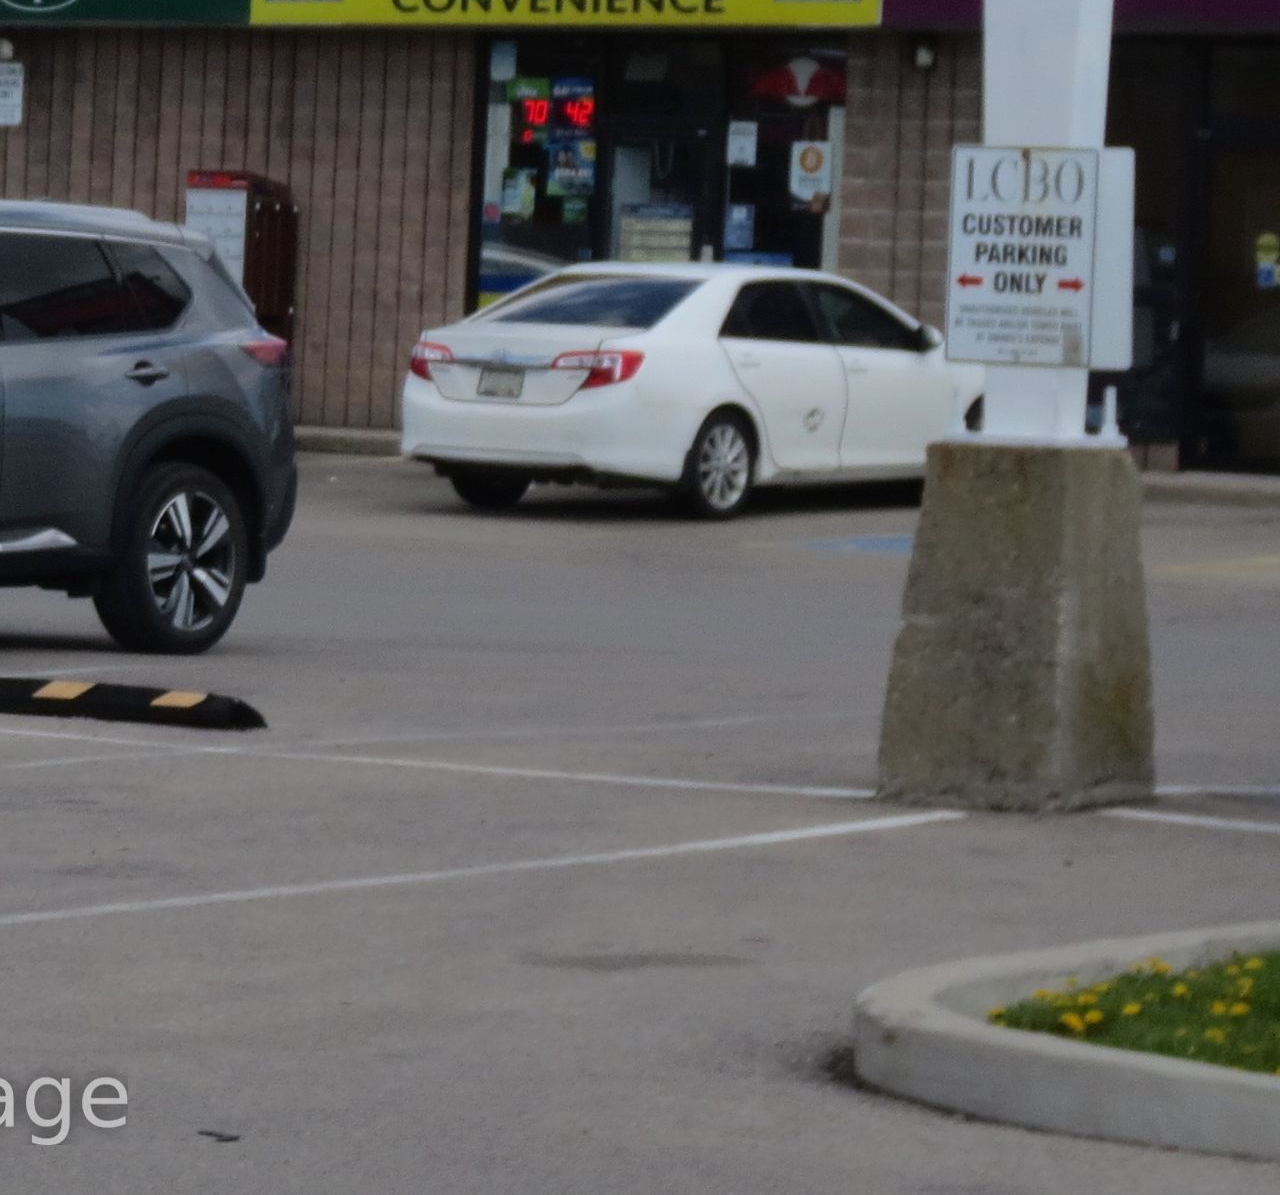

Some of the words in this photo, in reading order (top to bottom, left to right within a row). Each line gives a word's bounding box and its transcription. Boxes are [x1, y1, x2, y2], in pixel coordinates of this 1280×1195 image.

[966, 157, 1085, 203] LCBO
[963, 213, 1083, 238] CUSTOMER
[975, 243, 1067, 266] PARKING
[993, 272, 1048, 294] ONLY
